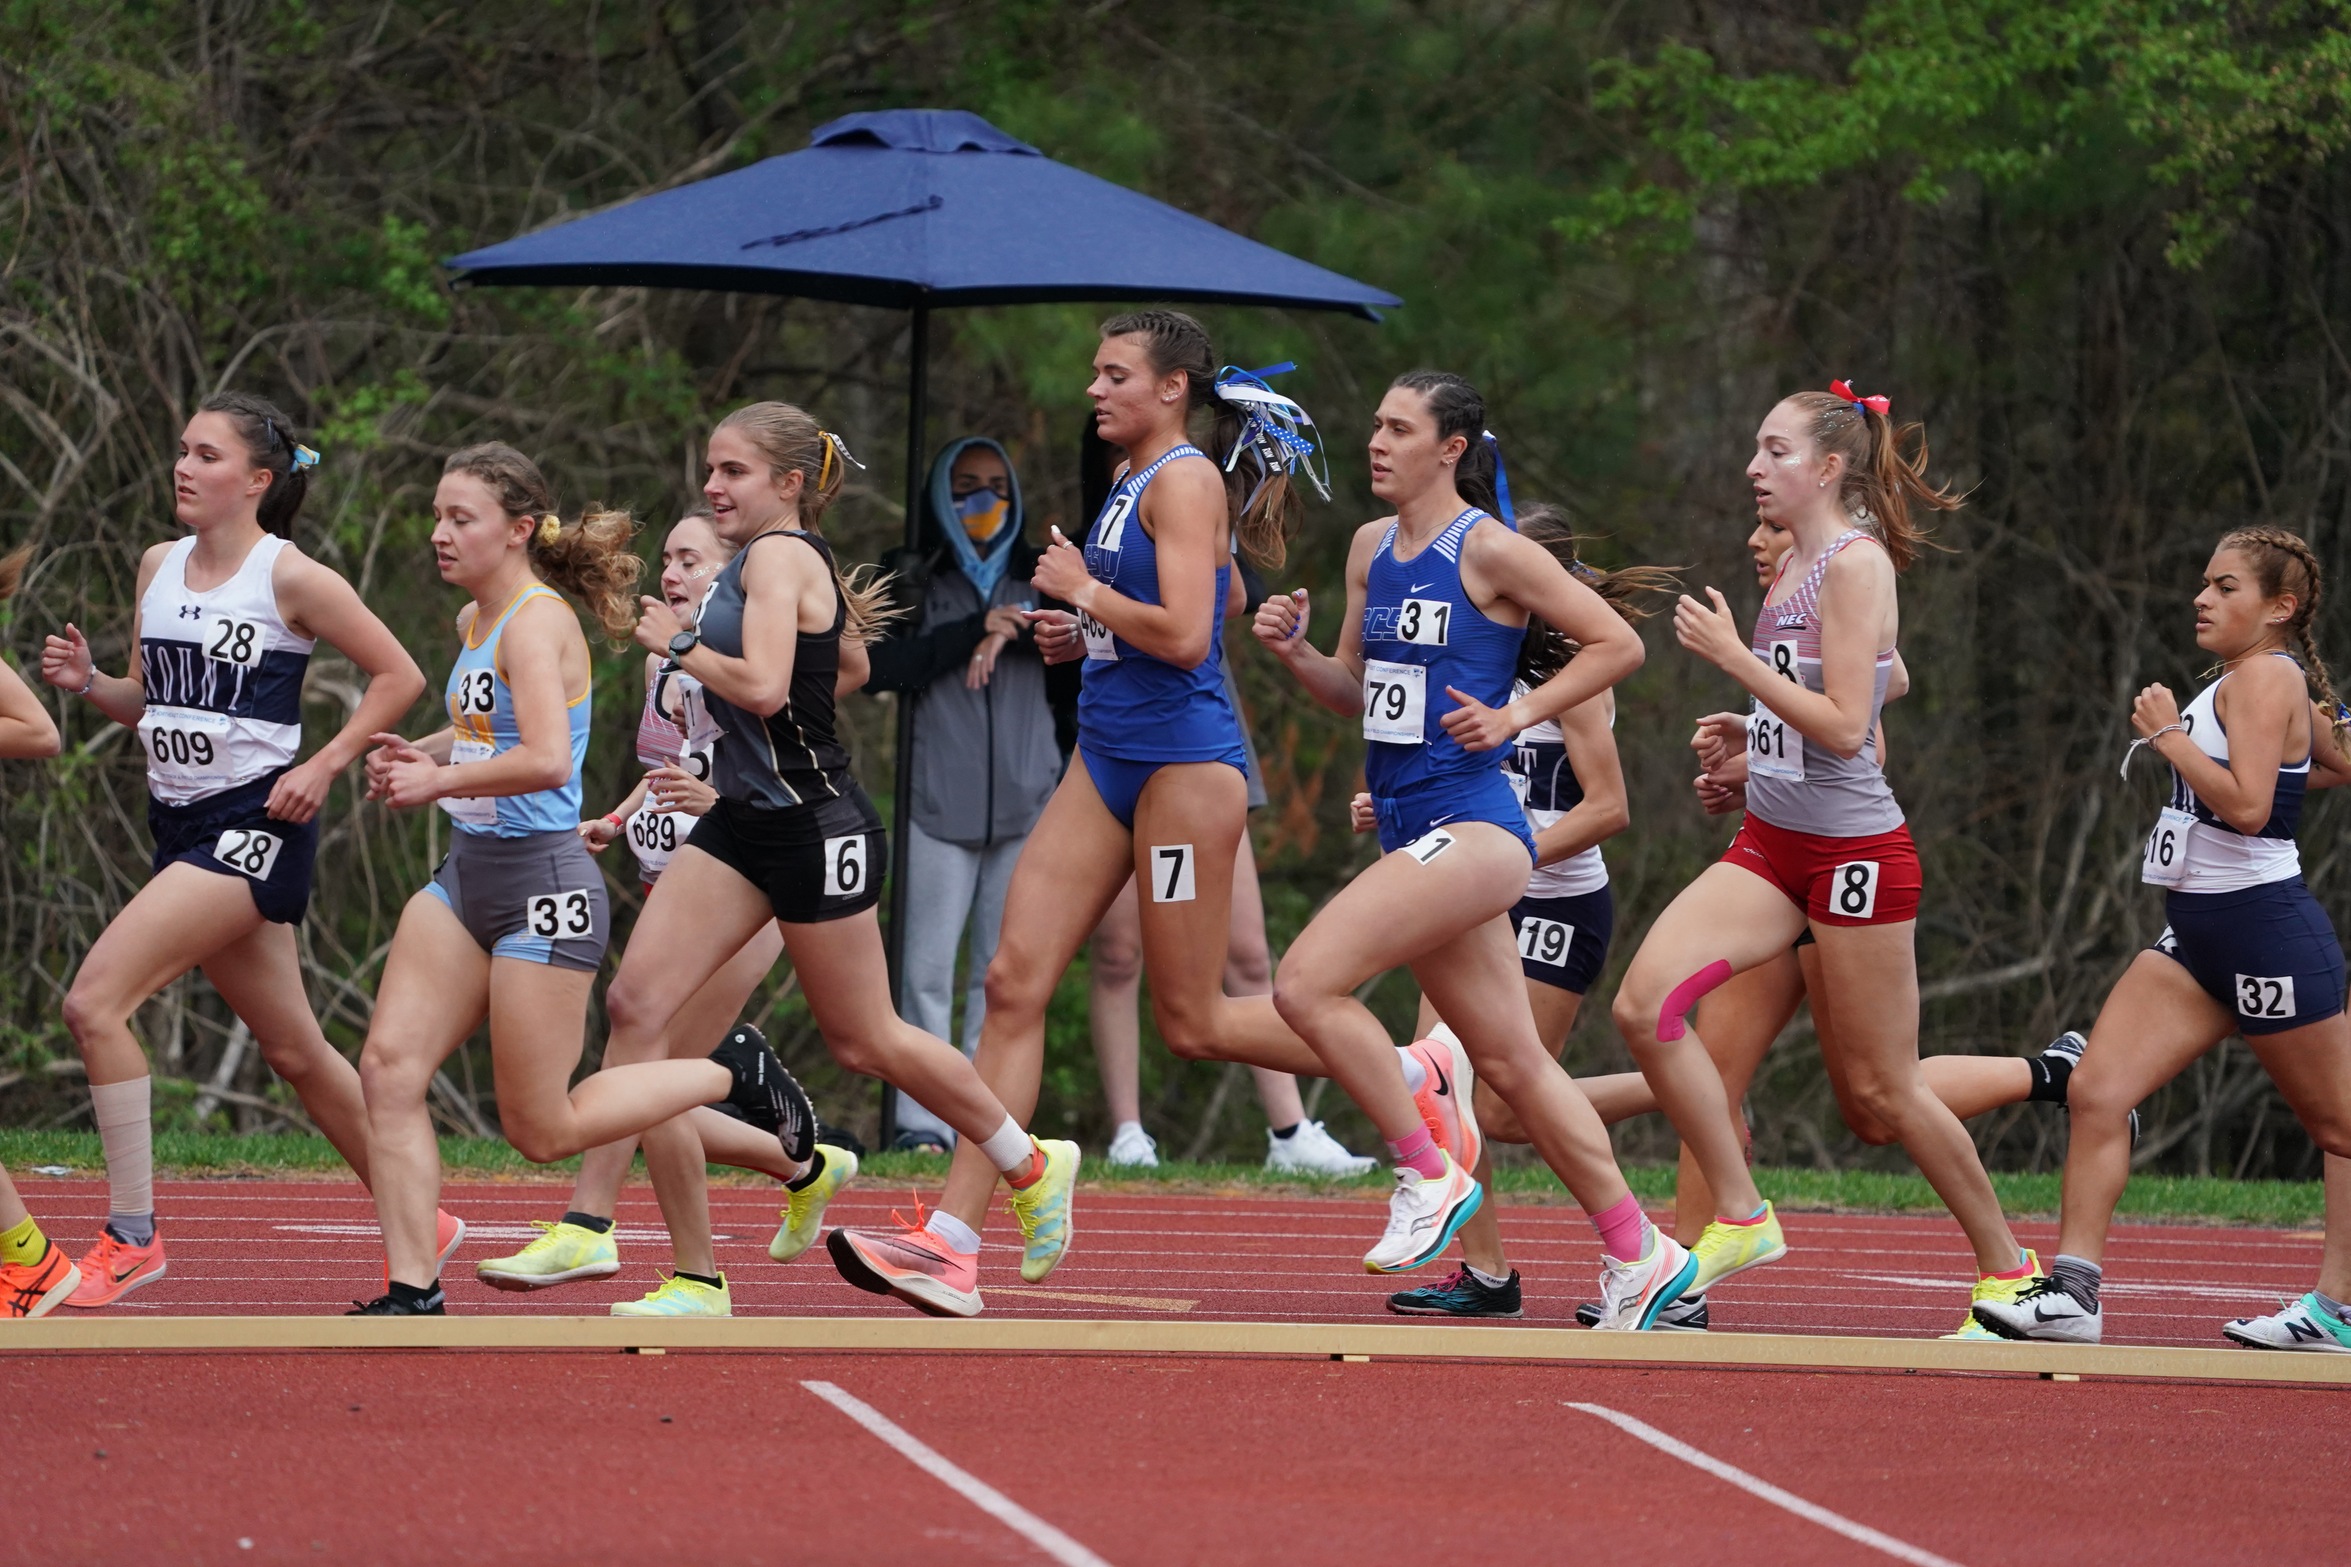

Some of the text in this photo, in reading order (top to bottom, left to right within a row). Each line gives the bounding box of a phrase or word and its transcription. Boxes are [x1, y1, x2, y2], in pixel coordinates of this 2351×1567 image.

[1101, 499, 1128, 545] 7
[209, 618, 256, 663] 28
[1401, 601, 1449, 644] 31
[1775, 612, 1808, 627] NEC
[460, 671, 495, 713] 33
[1366, 680, 1407, 721] 79
[152, 726, 214, 766] 609
[223, 830, 272, 874] 28
[633, 811, 676, 852] 689
[837, 839, 860, 891] 6
[1159, 849, 1184, 899] 7
[1840, 863, 1869, 914] 8
[534, 893, 590, 937] 33
[1526, 920, 1565, 962] 19
[2241, 977, 2286, 1017] 32
